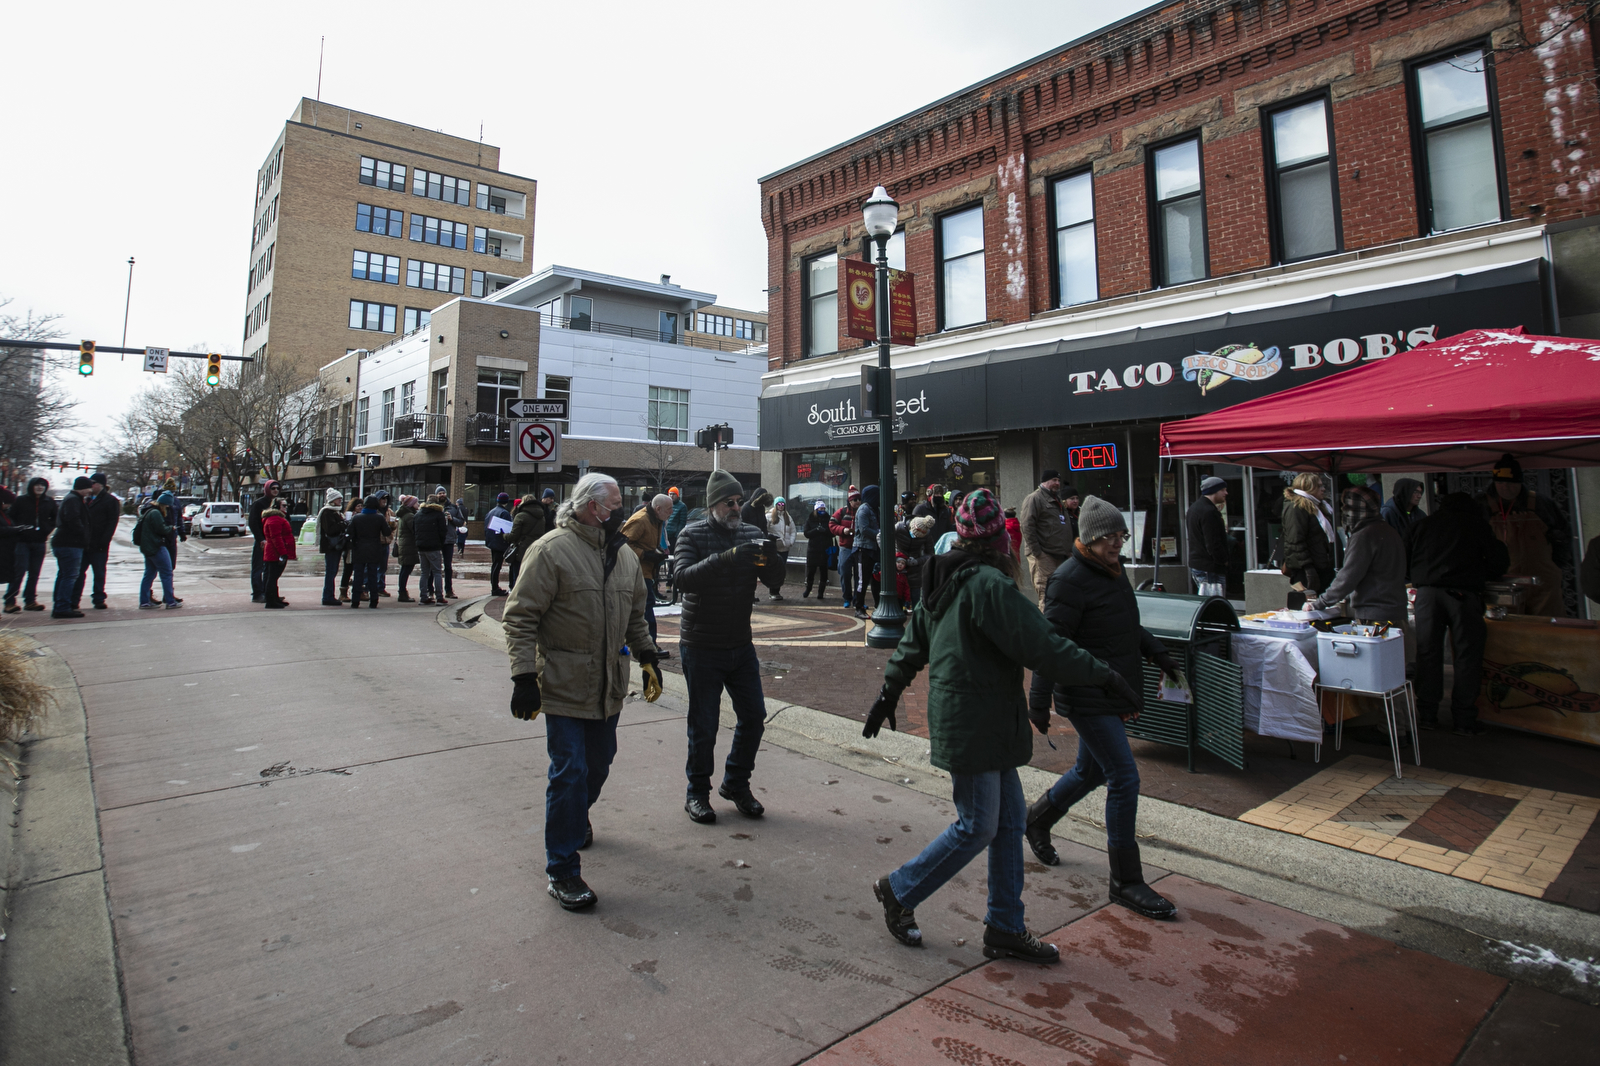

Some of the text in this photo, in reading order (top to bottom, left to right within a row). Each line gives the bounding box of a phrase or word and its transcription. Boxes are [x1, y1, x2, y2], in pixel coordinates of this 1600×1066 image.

[149, 348, 165, 356] ONE
[1068, 324, 1438, 395] TACO BOB'S
[1184, 356, 1279, 378] TACO BOB'S
[522, 404, 561, 413] ONE WAY
[807, 398, 857, 425] South
[836, 425, 859, 435] CIGAR
[1070, 446, 1115, 469] OPEN
[1483, 669, 1591, 711] TACO BOB'S
